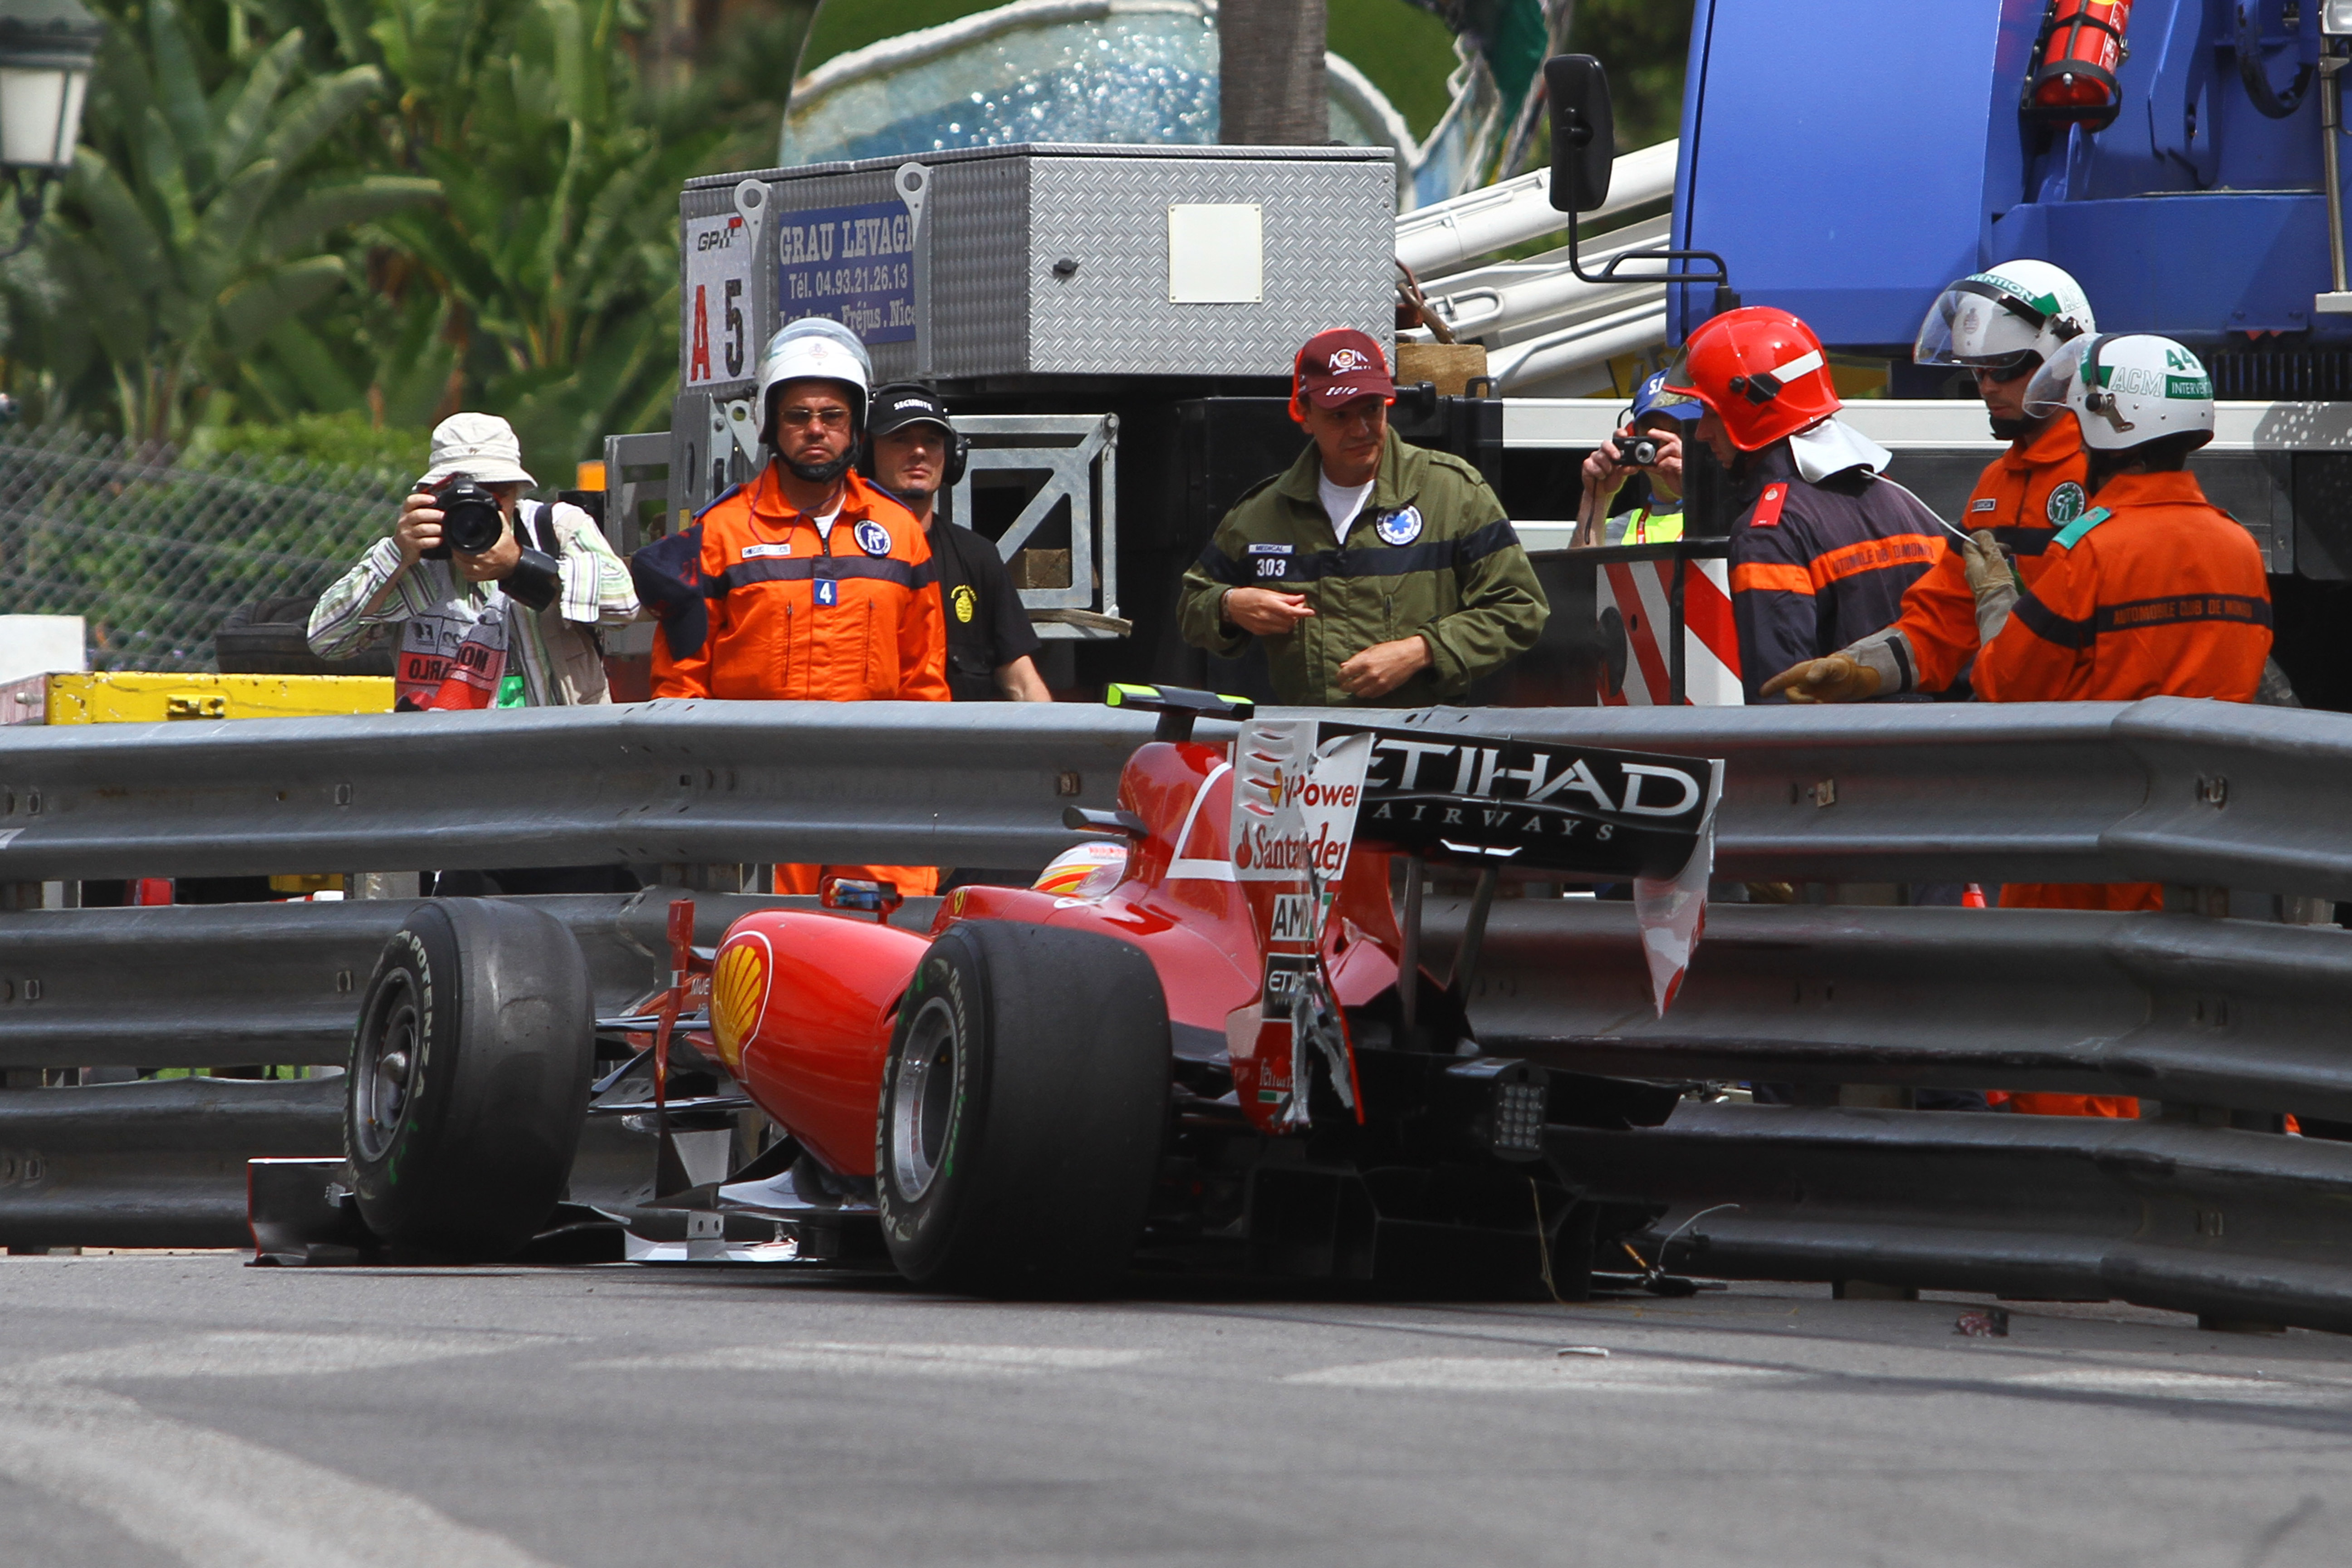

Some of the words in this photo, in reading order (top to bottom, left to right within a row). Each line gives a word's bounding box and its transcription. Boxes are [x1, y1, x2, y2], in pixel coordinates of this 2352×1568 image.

[779, 223, 835, 265] GRAU
[789, 274, 812, 299] Tél.
[817, 263, 907, 296] 04.93.21.26.13
[690, 284, 711, 382] A
[724, 279, 744, 377] 5
[841, 301, 881, 337] Fréjus
[1328, 348, 1368, 368] ACM
[2111, 367, 2164, 397] ACM
[1256, 559, 1286, 576] 303
[819, 582, 832, 603] 4
[1372, 802, 1614, 841] AIRWAYS
[410, 935, 432, 1098] POTENZA
